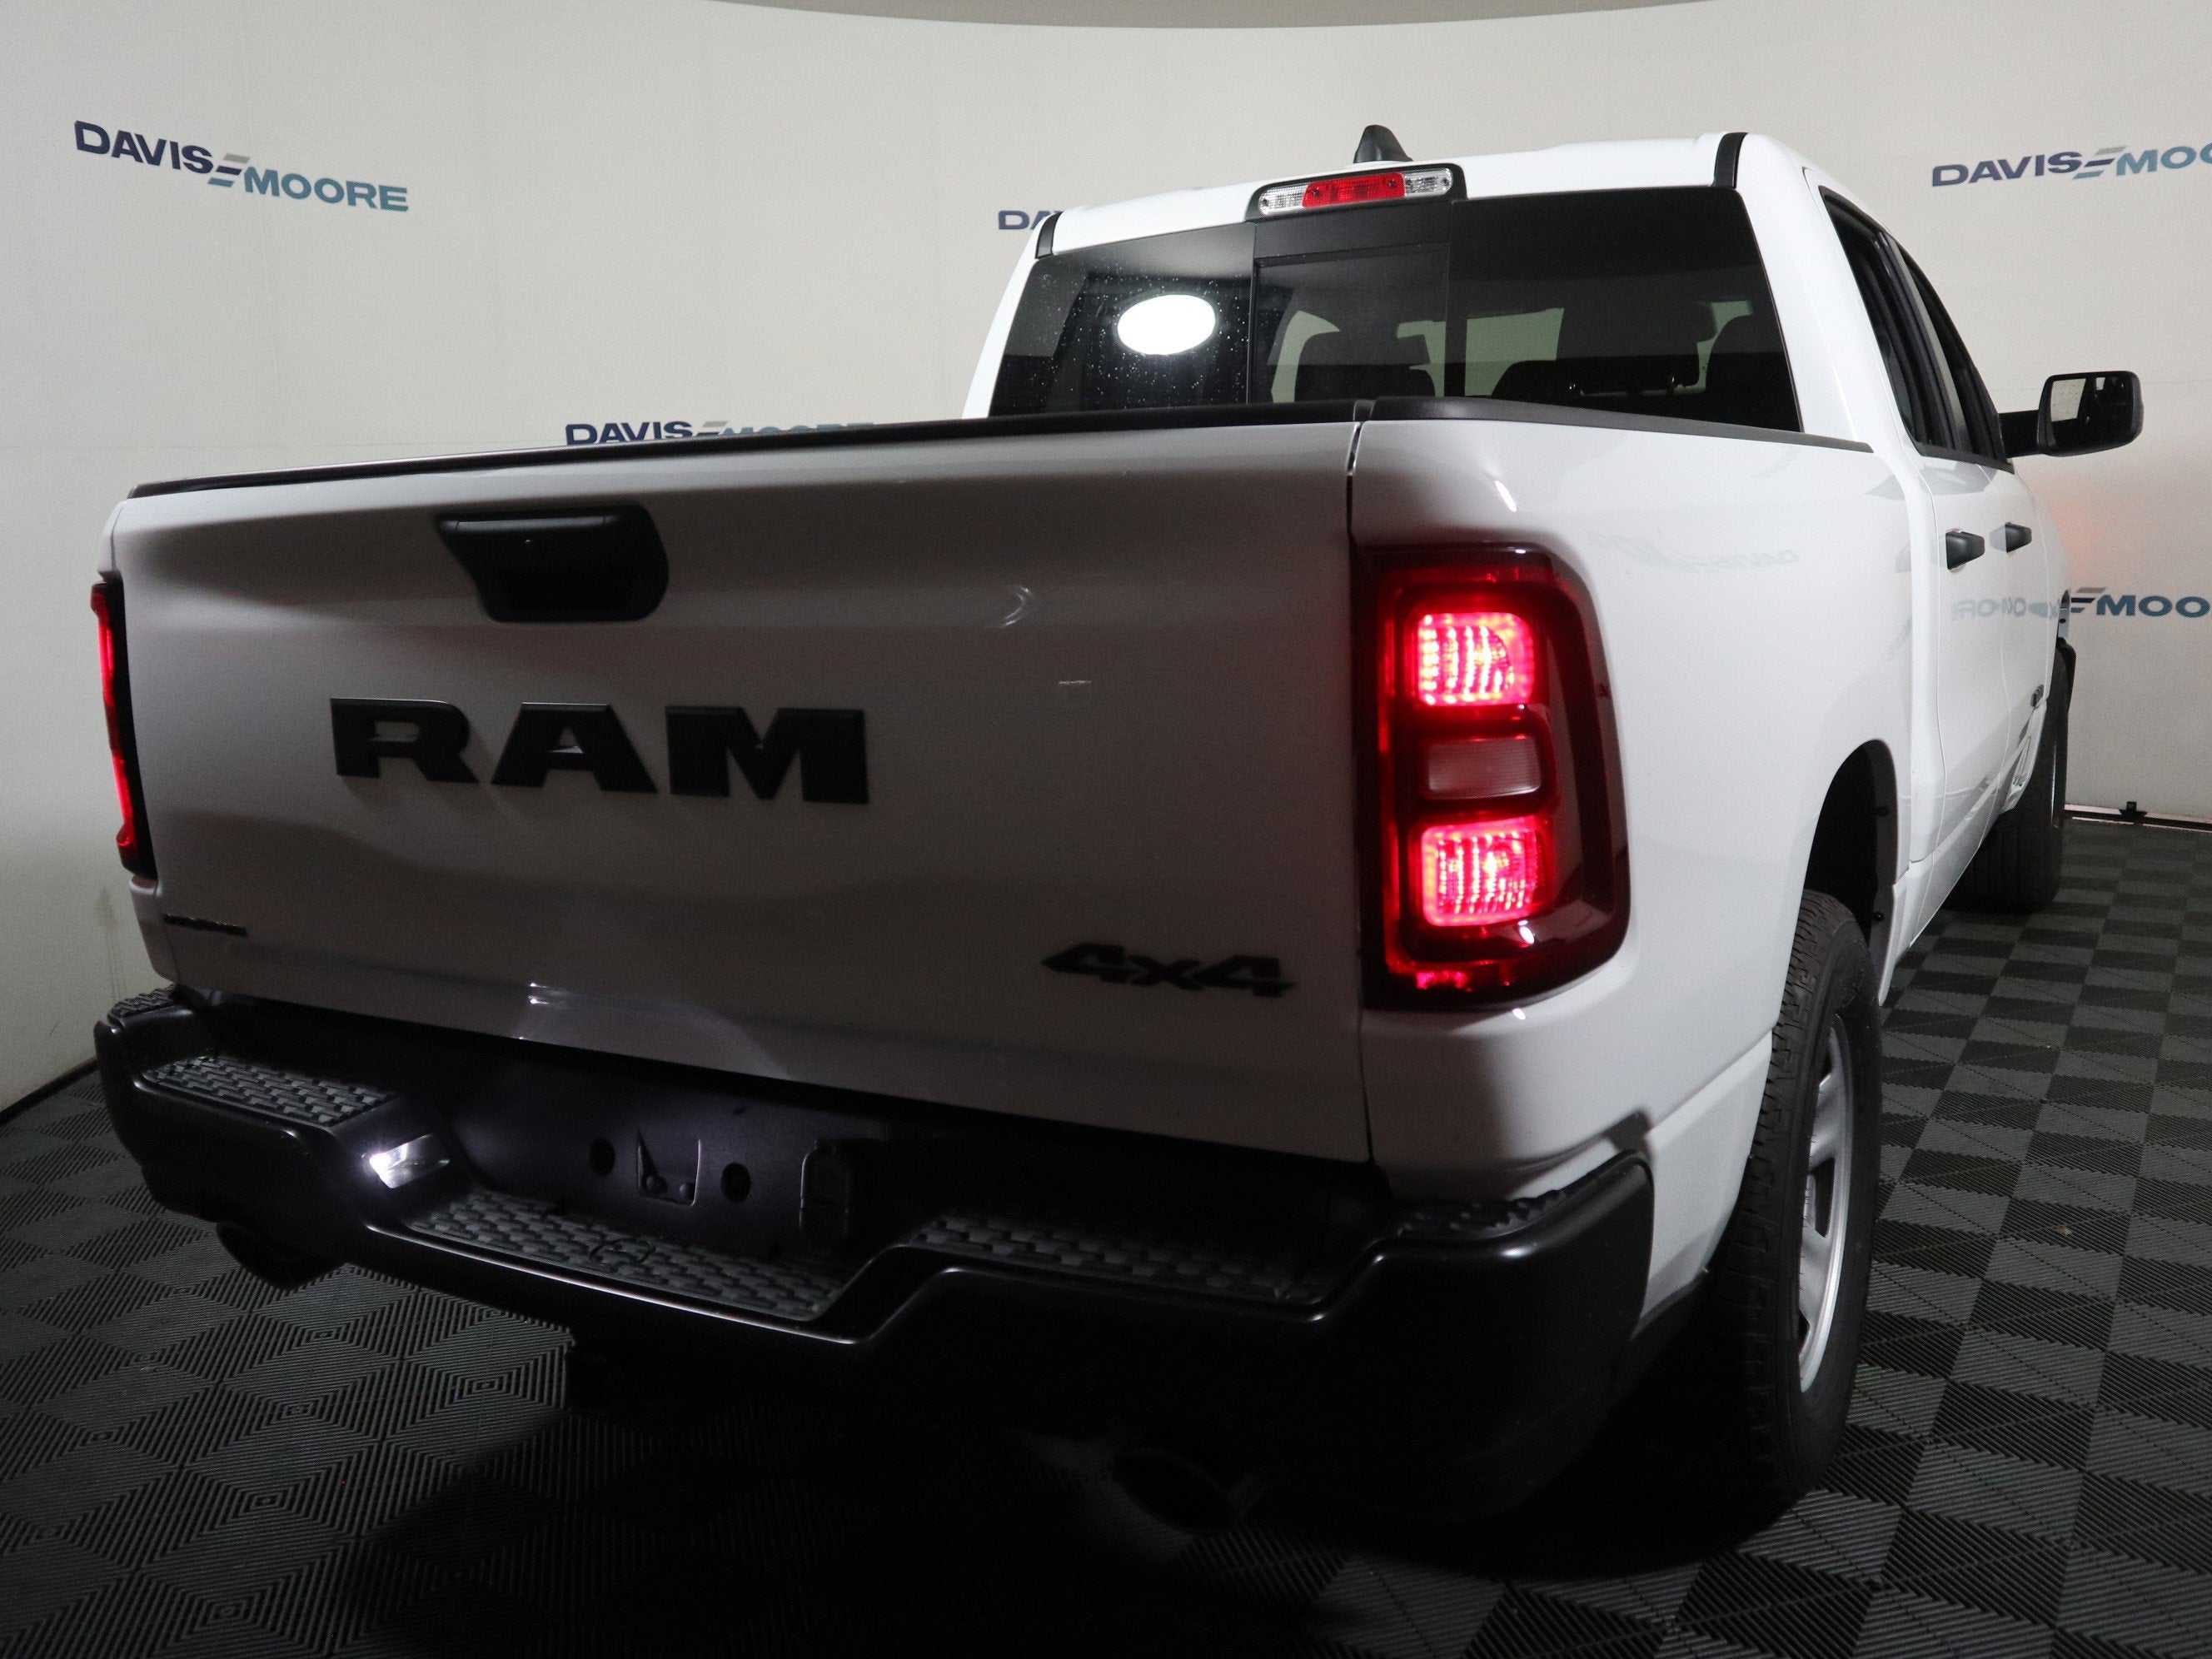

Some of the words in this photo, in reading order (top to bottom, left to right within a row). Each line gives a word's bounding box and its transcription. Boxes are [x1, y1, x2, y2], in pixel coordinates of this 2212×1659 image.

[74, 120, 213, 174] DAVIS
[244, 167, 409, 212] MOORE
[1931, 152, 2083, 187] DAVIS
[565, 421, 693, 446] DAVIS
[330, 697, 869, 805] RAM
